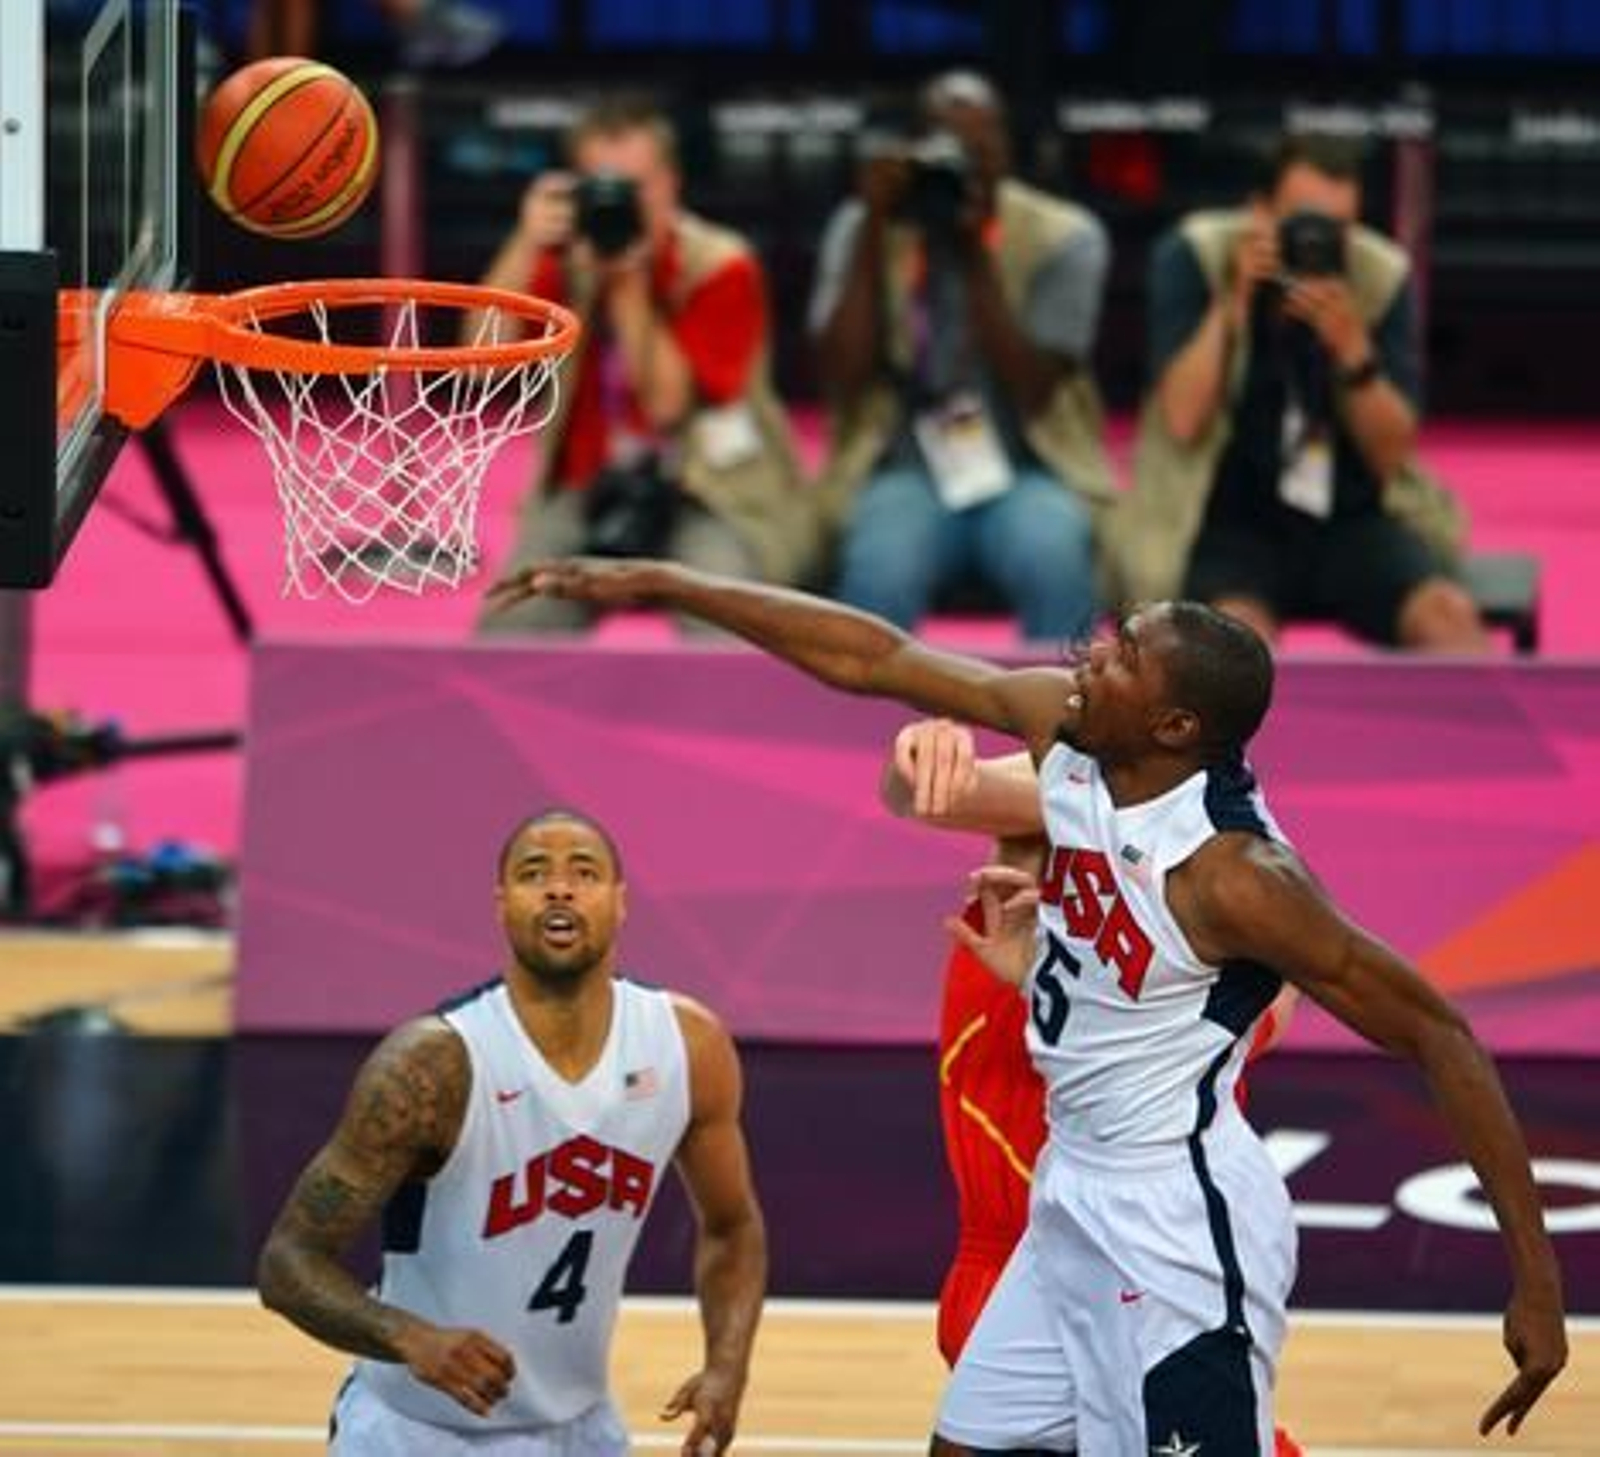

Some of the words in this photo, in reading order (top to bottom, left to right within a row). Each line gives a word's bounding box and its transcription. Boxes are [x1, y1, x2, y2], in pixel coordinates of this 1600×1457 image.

[1040, 844, 1156, 1004] USA
[1031, 928, 1081, 1047] 5
[482, 1133, 656, 1240] USA
[527, 1228, 594, 1324] 4
